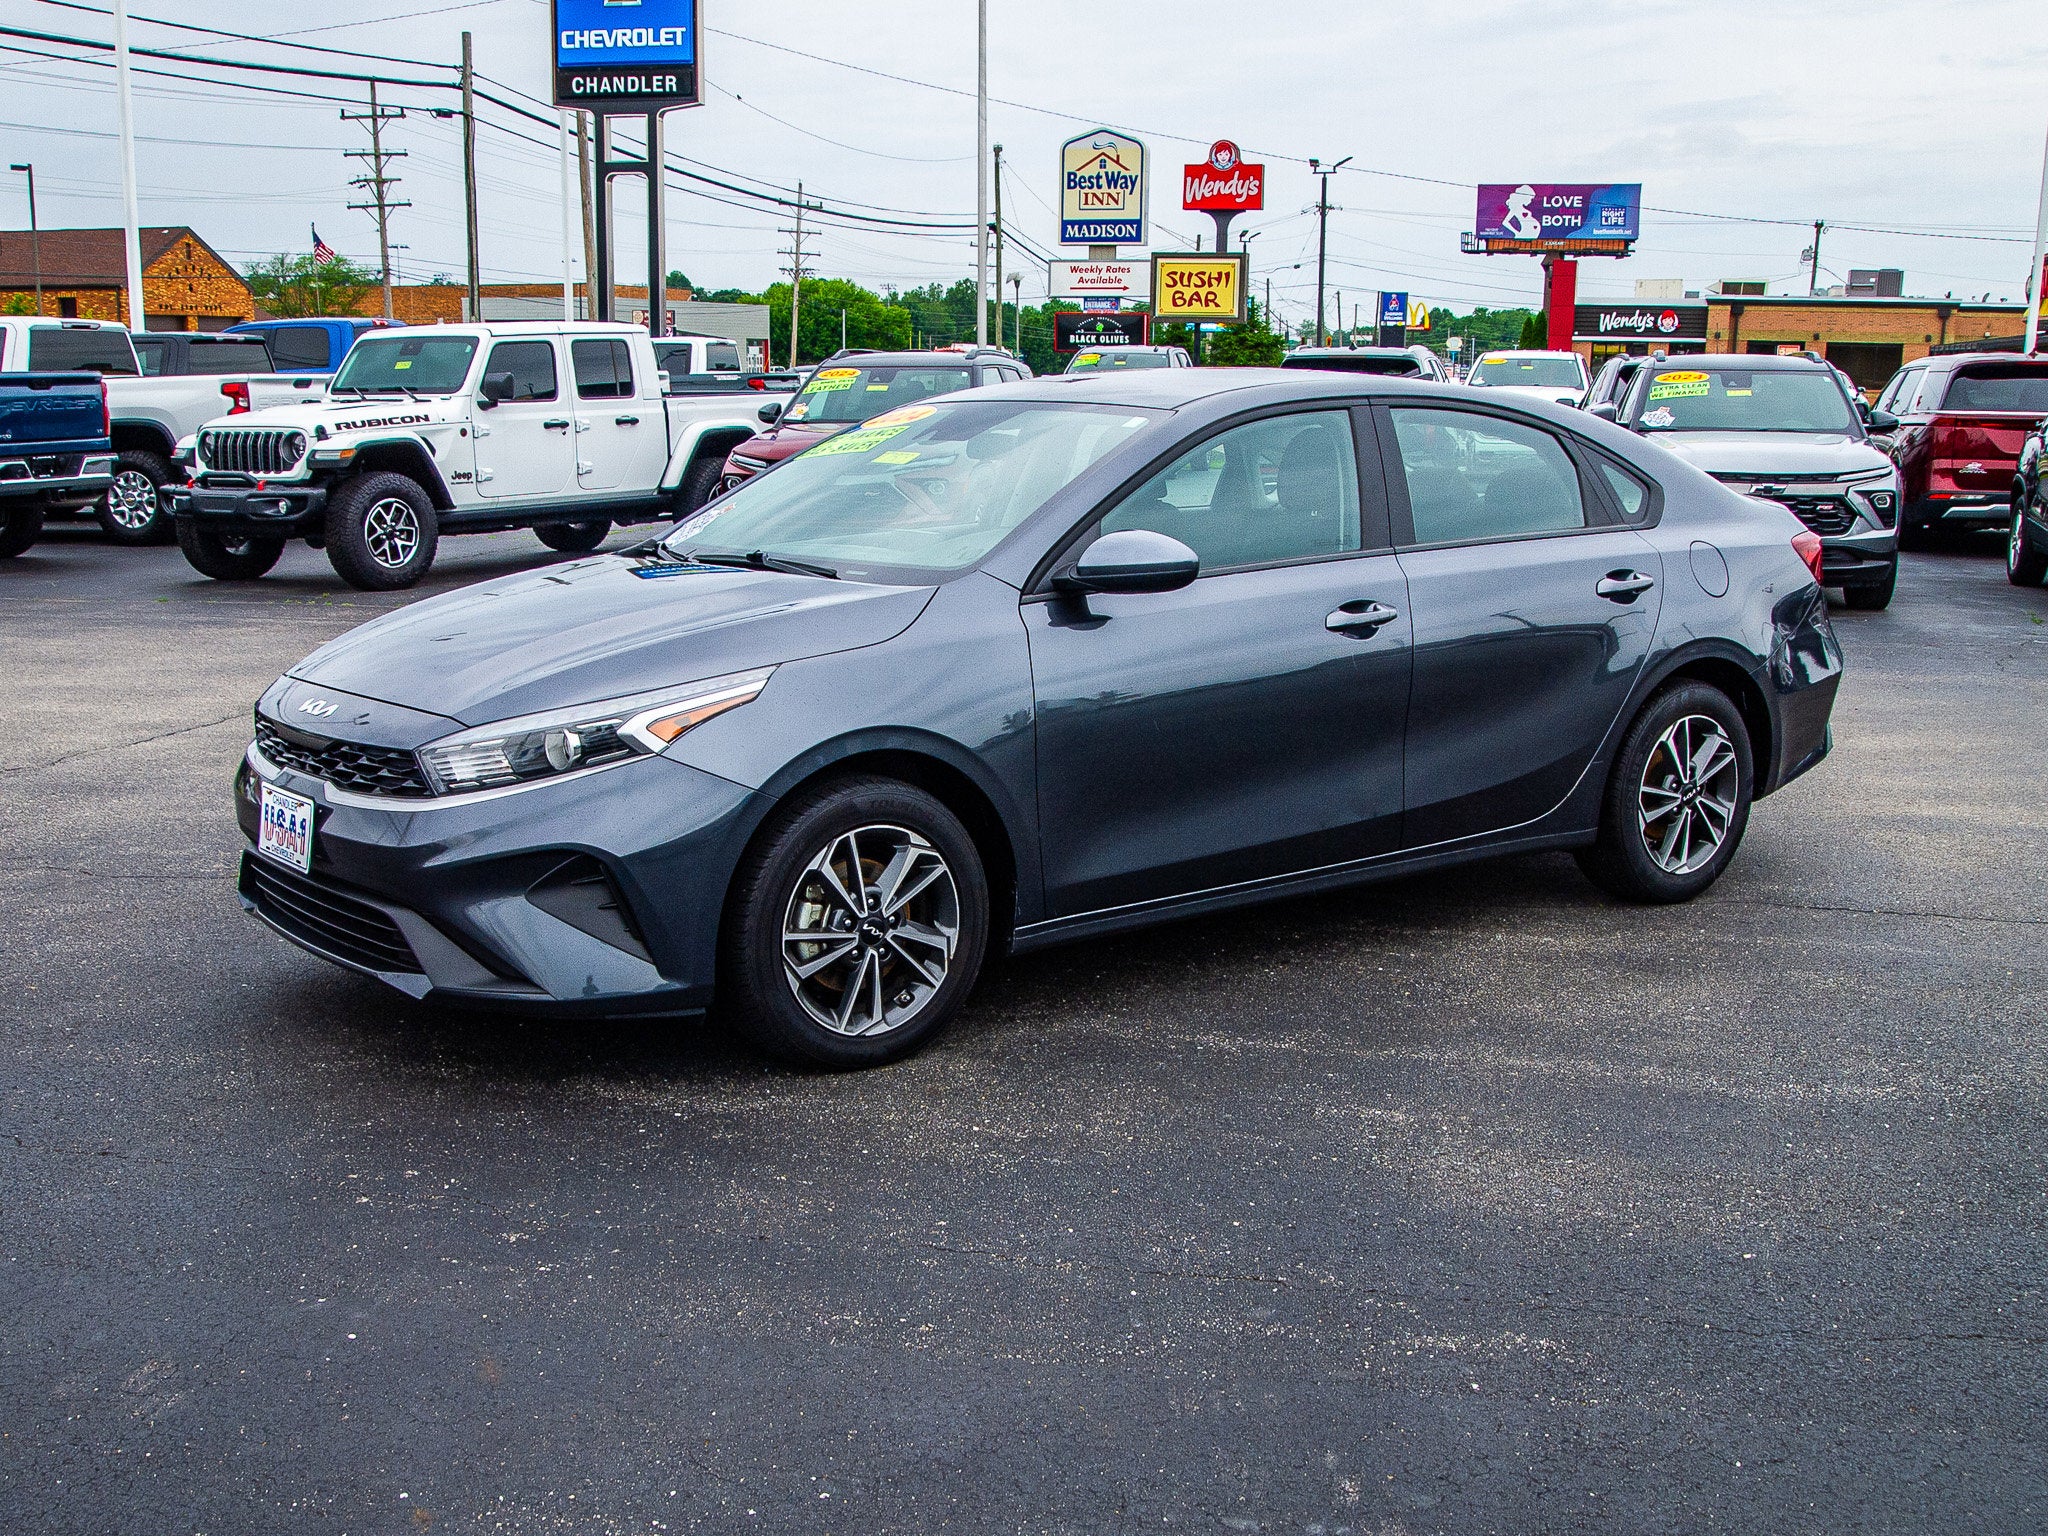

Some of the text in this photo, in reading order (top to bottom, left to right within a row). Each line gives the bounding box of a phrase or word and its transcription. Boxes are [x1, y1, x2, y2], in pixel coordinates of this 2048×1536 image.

[561, 27, 687, 49] CHEVROLET
[571, 75, 678, 94] CHANDLER
[1066, 171, 1139, 195] Best Way
[1185, 171, 1259, 203] Wendy's
[1082, 192, 1121, 206] INN
[1542, 196, 1583, 208] LOVE
[1541, 215, 1582, 227] BOTH
[1601, 210, 1625, 218] RIGHT
[1601, 217, 1625, 226] LIFE
[1065, 224, 1137, 238] MADISON
[1070, 265, 1131, 275] Weekly Rates
[1077, 276, 1123, 285] Available
[1165, 270, 1231, 288] SUSHI
[1171, 290, 1221, 308] BAR
[1600, 310, 1655, 333] Wendy's
[1069, 334, 1130, 344] BLACK OLIVES
[1653, 385, 1680, 393] EXTRA
[1667, 389, 1706, 397] FINANCE
[335, 414, 430, 430] RUBICON
[451, 470, 473, 481] Jeep
[272, 794, 299, 812] CHANDLER
[271, 845, 295, 861] CHEVROLET
